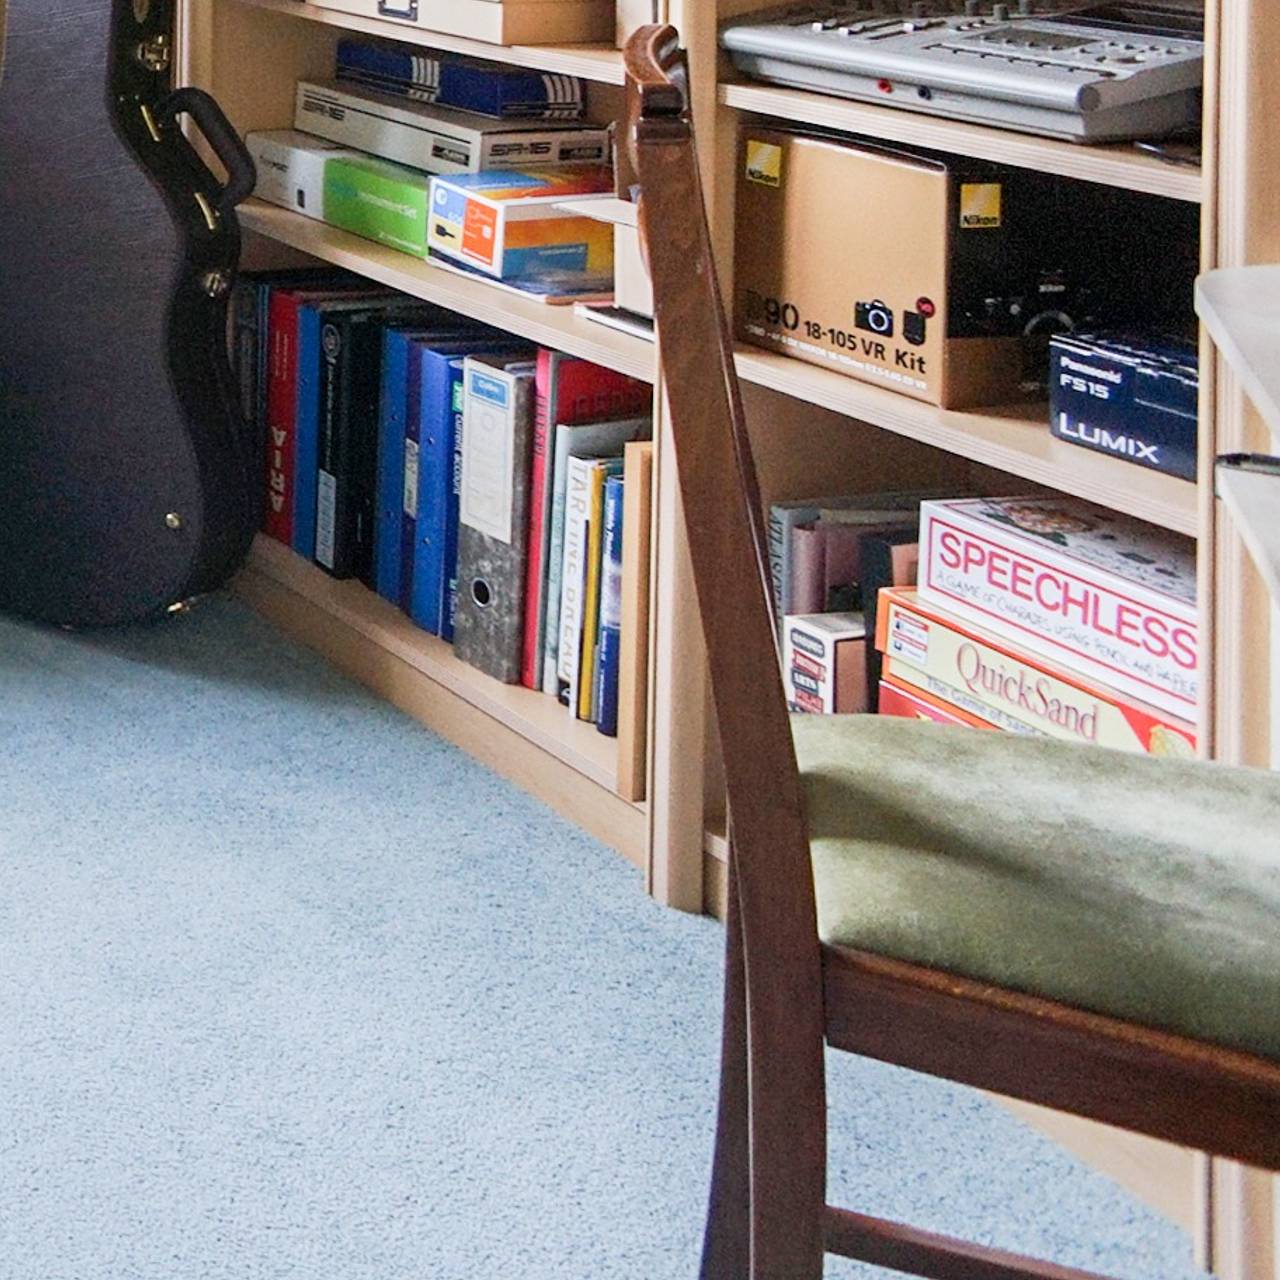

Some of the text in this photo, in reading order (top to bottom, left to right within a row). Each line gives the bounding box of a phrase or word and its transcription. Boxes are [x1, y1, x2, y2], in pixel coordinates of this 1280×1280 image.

[490, 141, 552, 157] SR-16
[748, 169, 779, 185] Nikon
[962, 214, 999, 226] Nikon
[804, 320, 858, 351] 18-105
[860, 337, 886, 361] VR
[894, 348, 926, 374] Kit
[1059, 355, 1122, 385] Panasonic
[1059, 373, 1110, 400] FS15
[1058, 411, 1161, 465] LUMIX
[939, 531, 1197, 670] SPEECHLESS
[956, 641, 1099, 742] QuickSand
